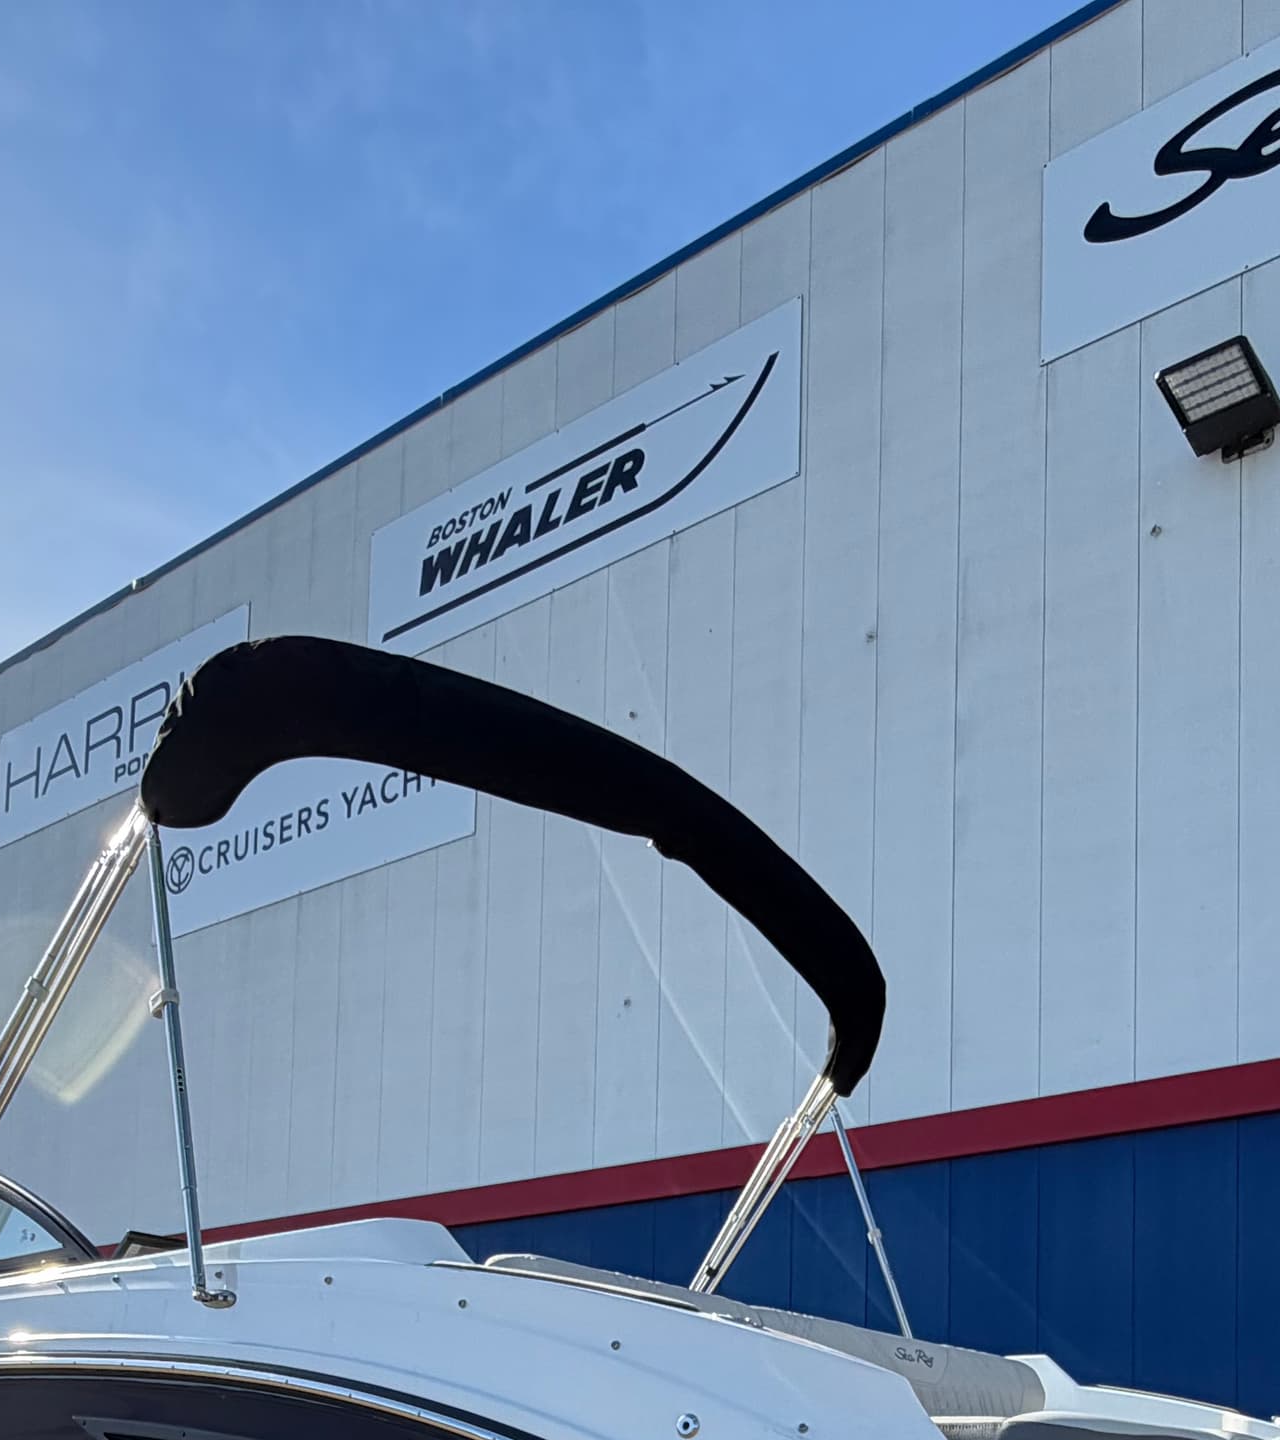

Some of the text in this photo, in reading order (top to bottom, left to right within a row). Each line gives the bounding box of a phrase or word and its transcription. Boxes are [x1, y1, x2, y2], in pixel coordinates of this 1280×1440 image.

[419, 448, 645, 598] WHALER
[426, 487, 512, 549] BOSTON
[4, 671, 185, 812] HARR
[198, 799, 329, 875] CRUISERS
[341, 769, 436, 819] YACH
